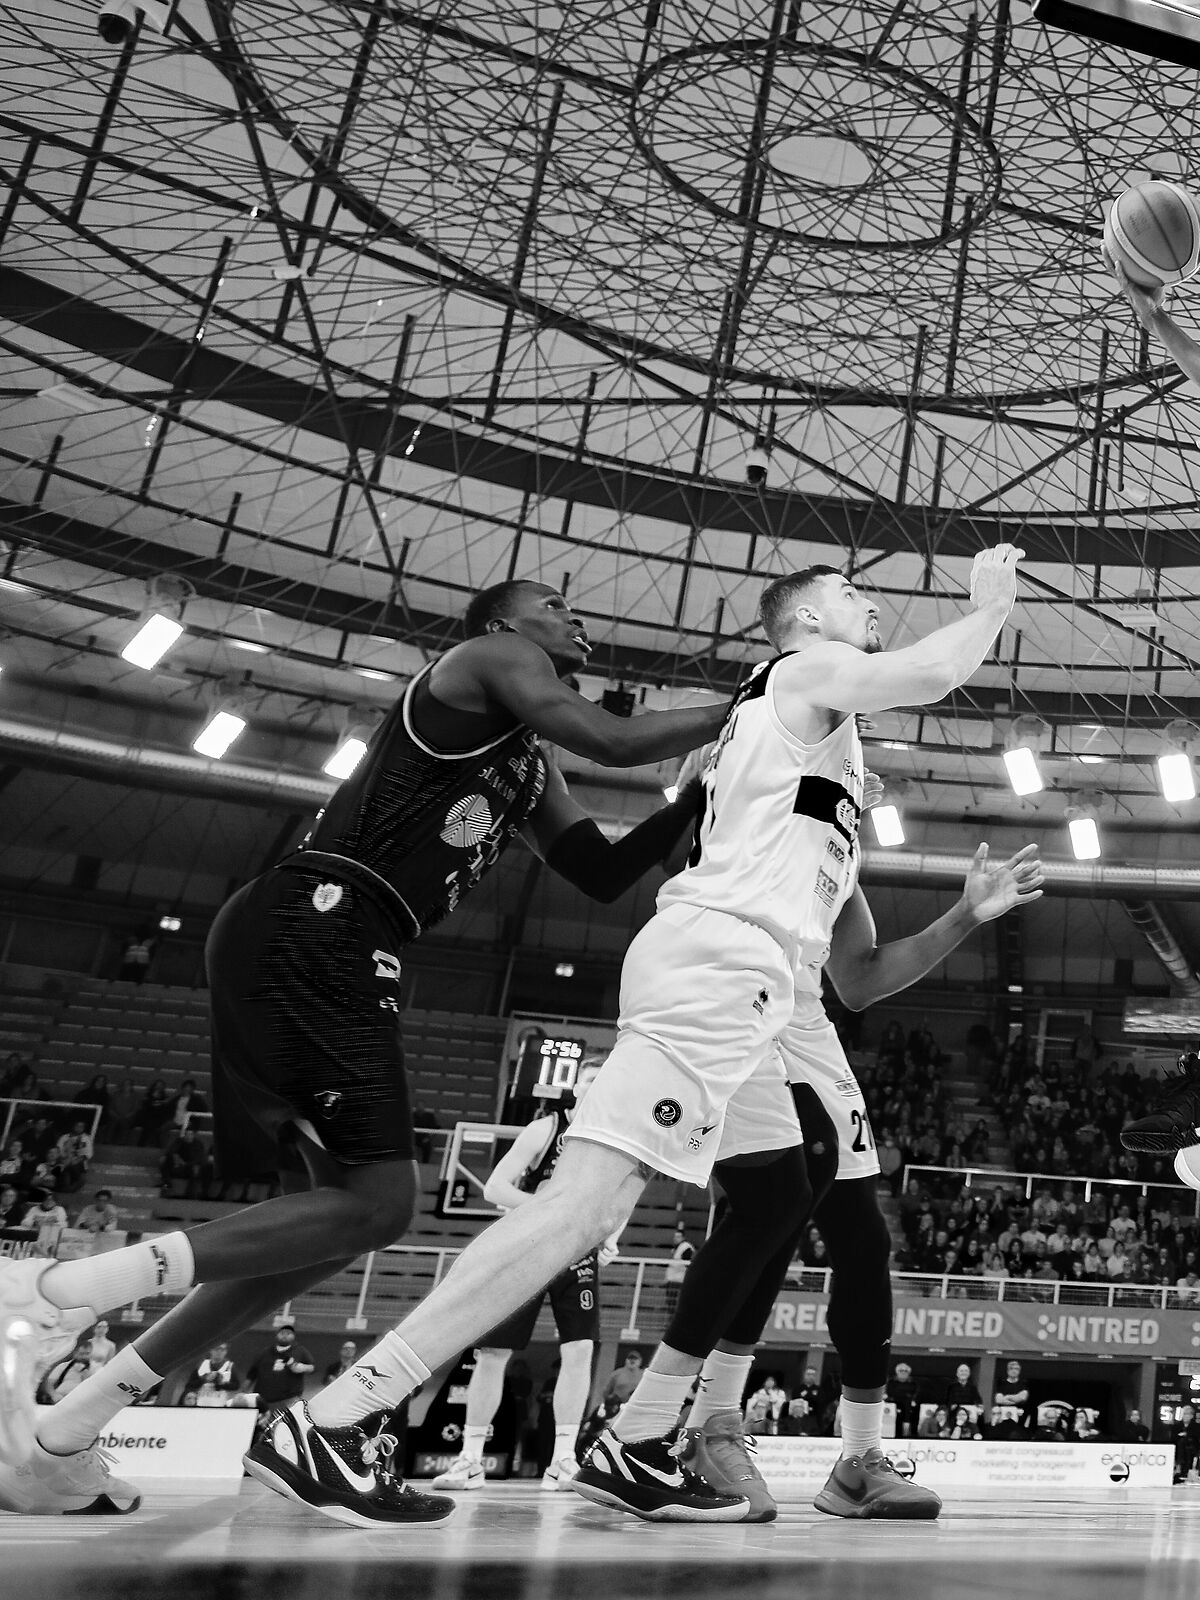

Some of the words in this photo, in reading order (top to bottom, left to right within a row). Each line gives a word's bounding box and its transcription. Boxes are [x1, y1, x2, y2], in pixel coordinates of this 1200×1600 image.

[540, 1038, 583, 1059] 2:56
[538, 1055, 579, 1090] 10
[580, 1289, 594, 1311] 9
[893, 1308, 1004, 1339] INTRED
[1057, 1315, 1160, 1345] INTRED
[351, 1371, 377, 1391] PRS
[97, 1432, 168, 1449] biente
